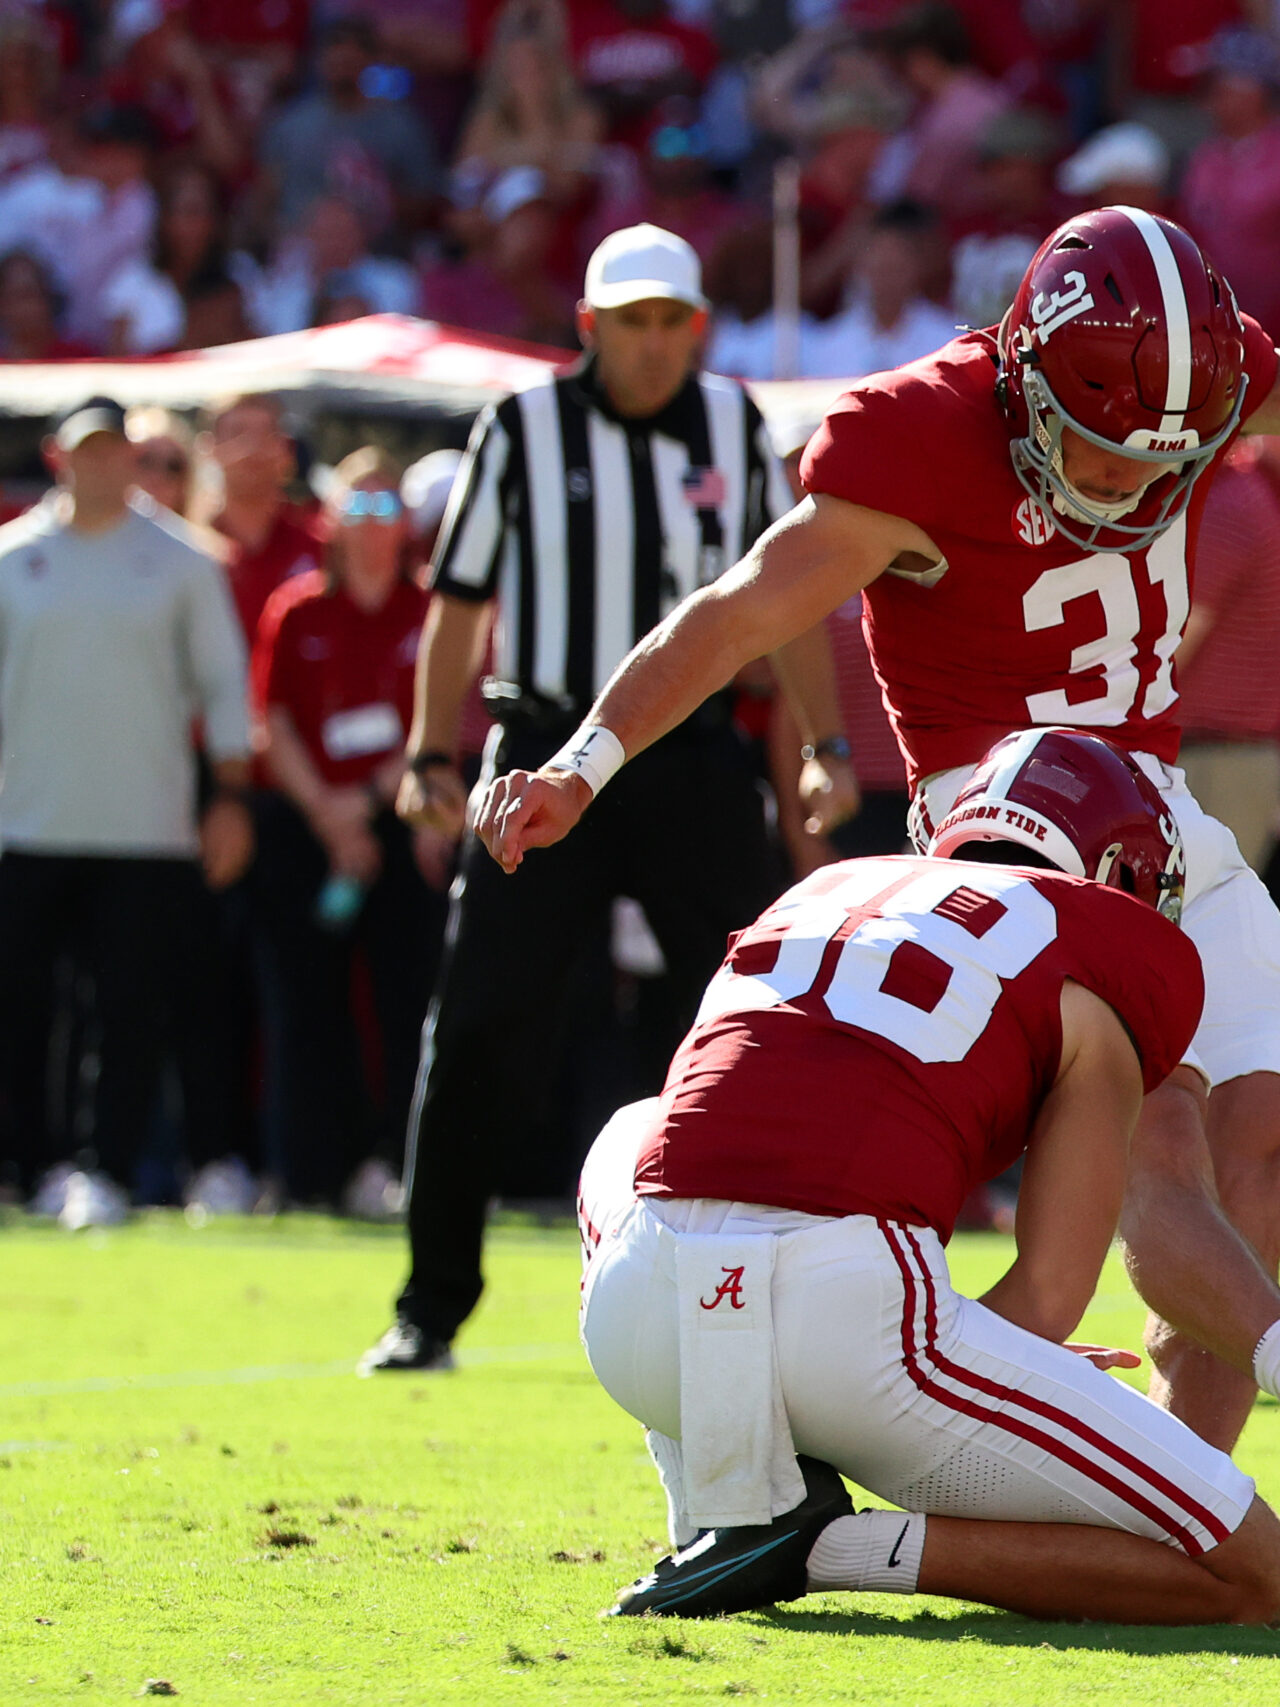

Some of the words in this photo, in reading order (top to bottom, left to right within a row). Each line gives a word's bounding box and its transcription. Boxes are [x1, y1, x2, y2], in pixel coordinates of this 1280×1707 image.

[1031, 270, 1095, 346] 31
[1147, 438, 1187, 452] BAMA
[1022, 506, 1192, 727] 31
[1005, 809, 1048, 842] TIDE
[700, 1265, 746, 1310] A
